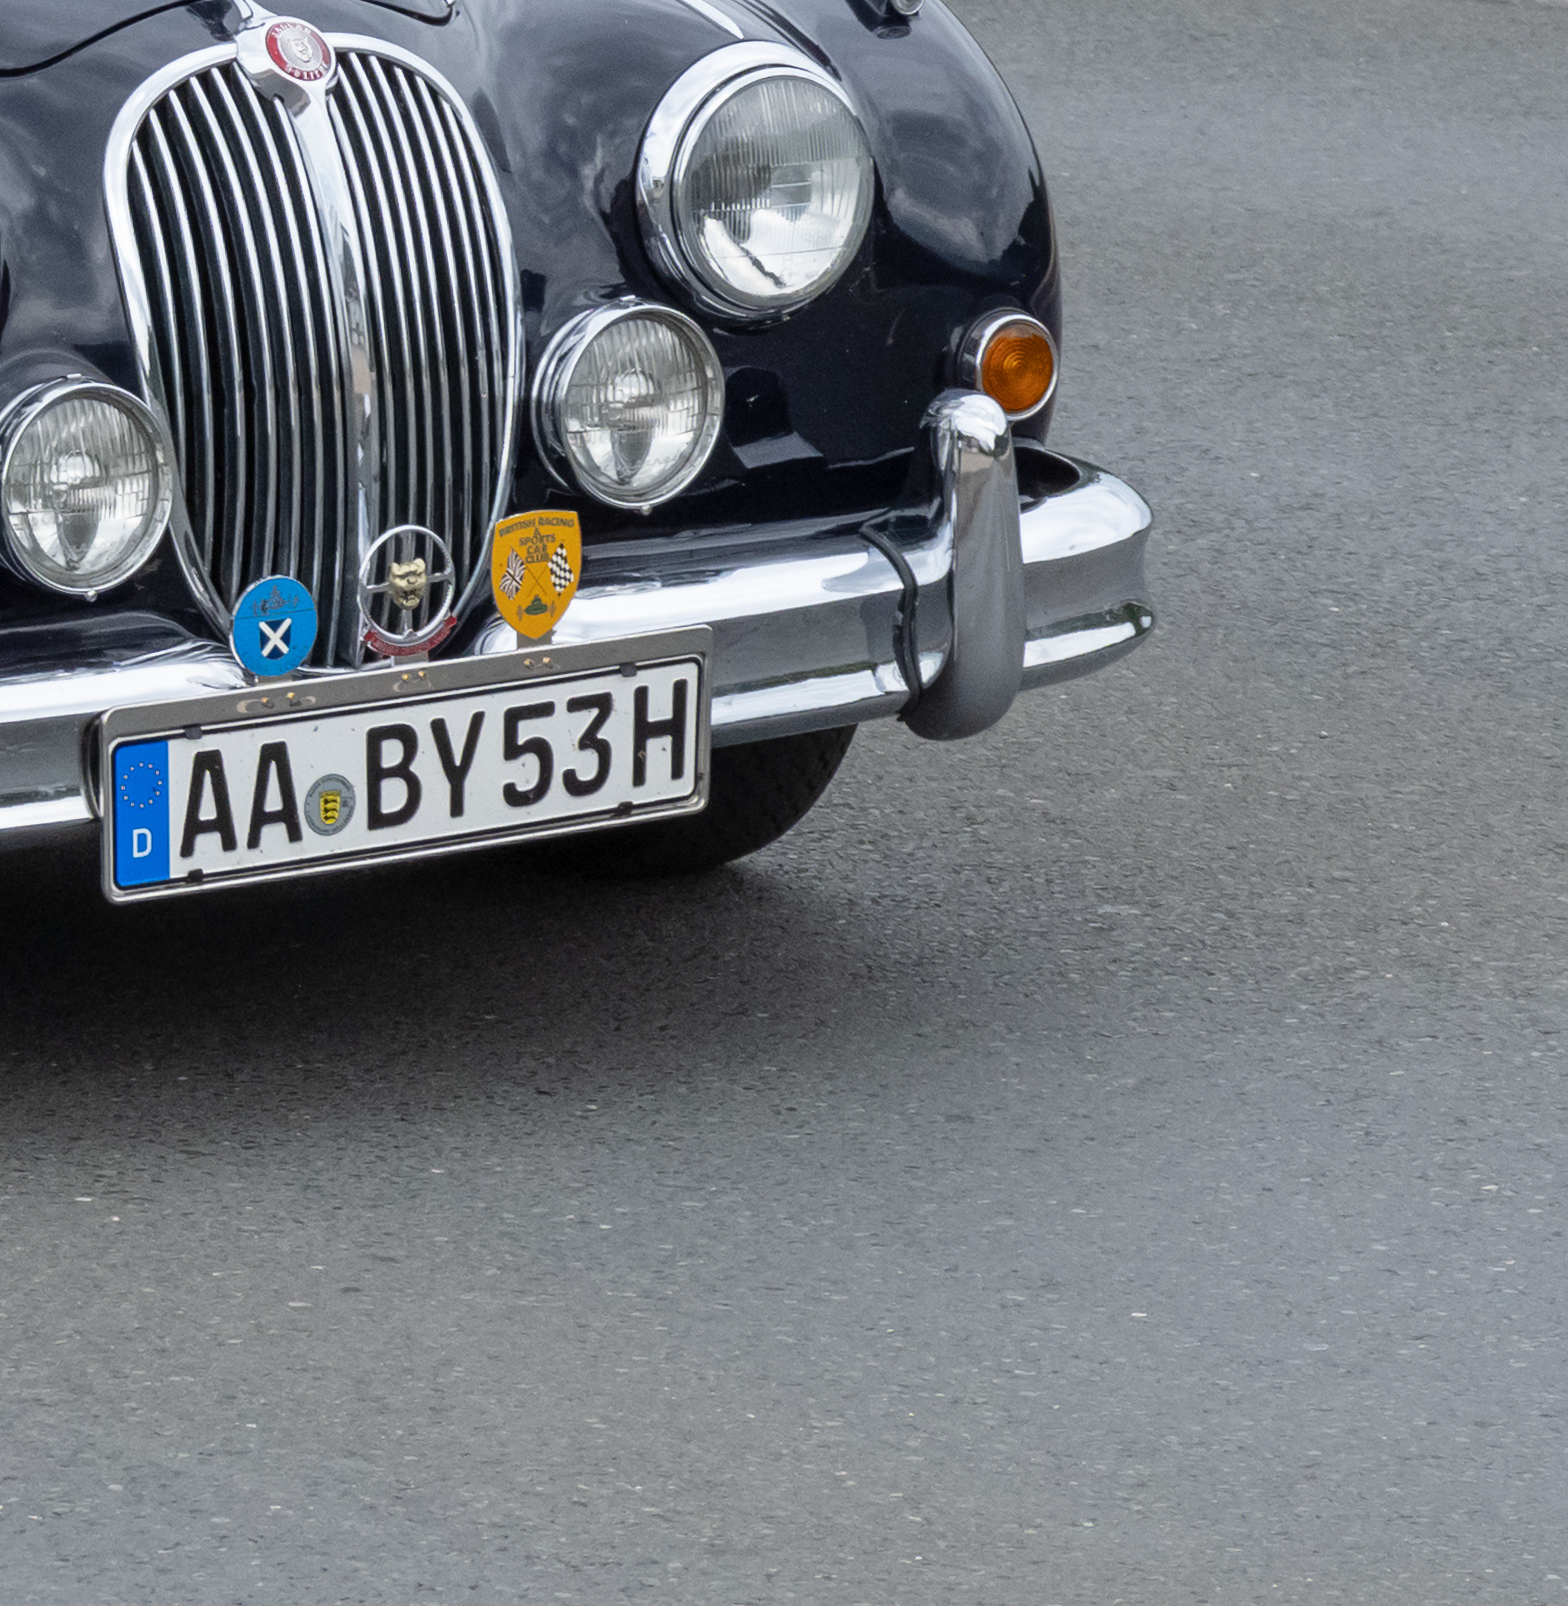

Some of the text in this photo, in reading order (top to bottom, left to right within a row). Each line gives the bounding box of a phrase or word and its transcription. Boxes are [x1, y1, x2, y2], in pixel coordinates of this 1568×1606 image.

[538, 517, 575, 528] RACING
[518, 533, 556, 546] SPORTS
[526, 544, 548, 554] CAR
[525, 553, 550, 564] CLUB
[180, 740, 303, 858] AA
[132, 827, 153, 859] D
